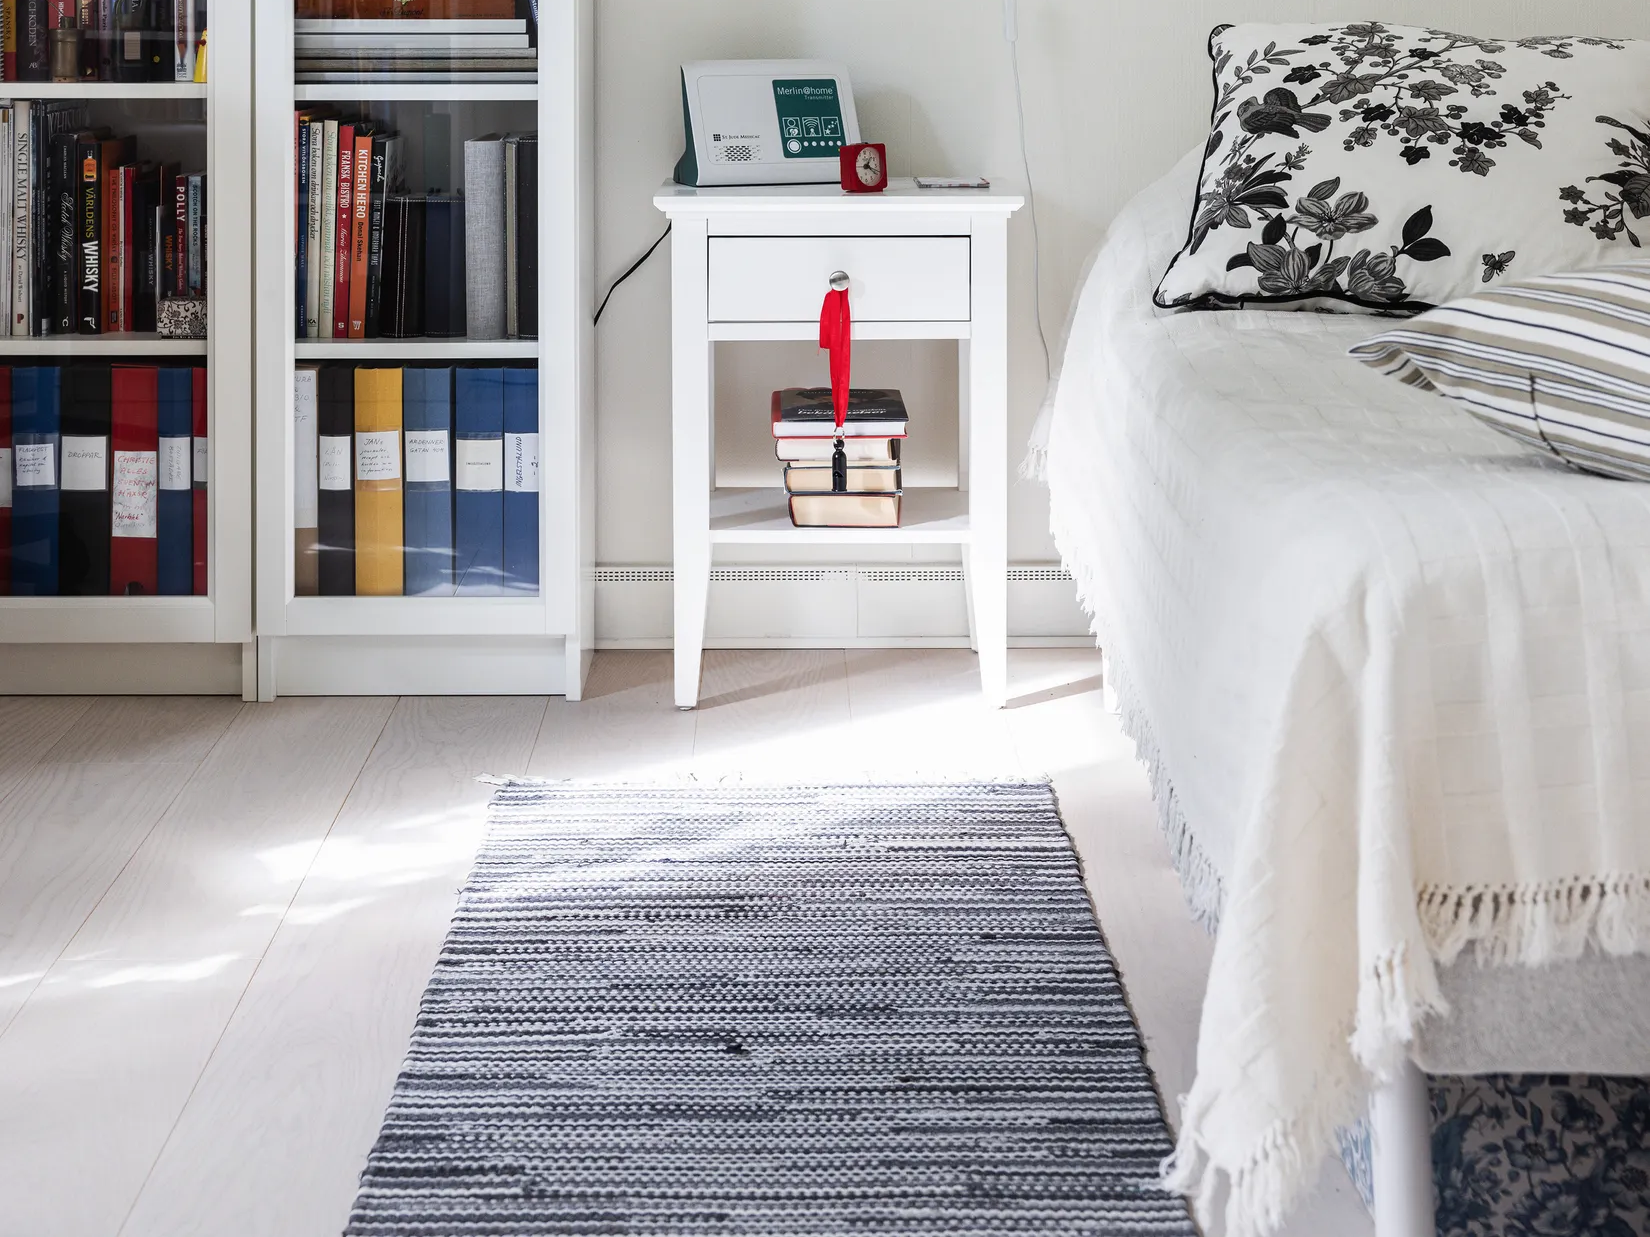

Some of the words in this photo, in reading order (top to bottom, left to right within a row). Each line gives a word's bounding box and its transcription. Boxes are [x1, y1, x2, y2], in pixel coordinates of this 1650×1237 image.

[777, 86, 833, 95] Merlin@home
[311, 128, 320, 146] Stora
[326, 130, 336, 152] Stora
[17, 132, 27, 175] SINGLE
[311, 147, 320, 166] boken
[326, 154, 335, 176] boken
[341, 150, 350, 179] FRANSK
[311, 167, 317, 178] om
[326, 177, 333, 190] om
[357, 149, 368, 191] KITCHEN
[16, 178, 27, 212] MALT
[60, 192, 74, 226] Scotch
[177, 186, 185, 222] POLLY
[340, 182, 349, 209] BISTRO
[356, 192, 367, 218] HERO
[85, 187, 96, 238] VÄRLDENS
[193, 207, 198, 216] ON
[16, 214, 27, 261] WHISKY
[57, 226, 73, 261] Whisky
[82, 240, 98, 293] WHISKY
